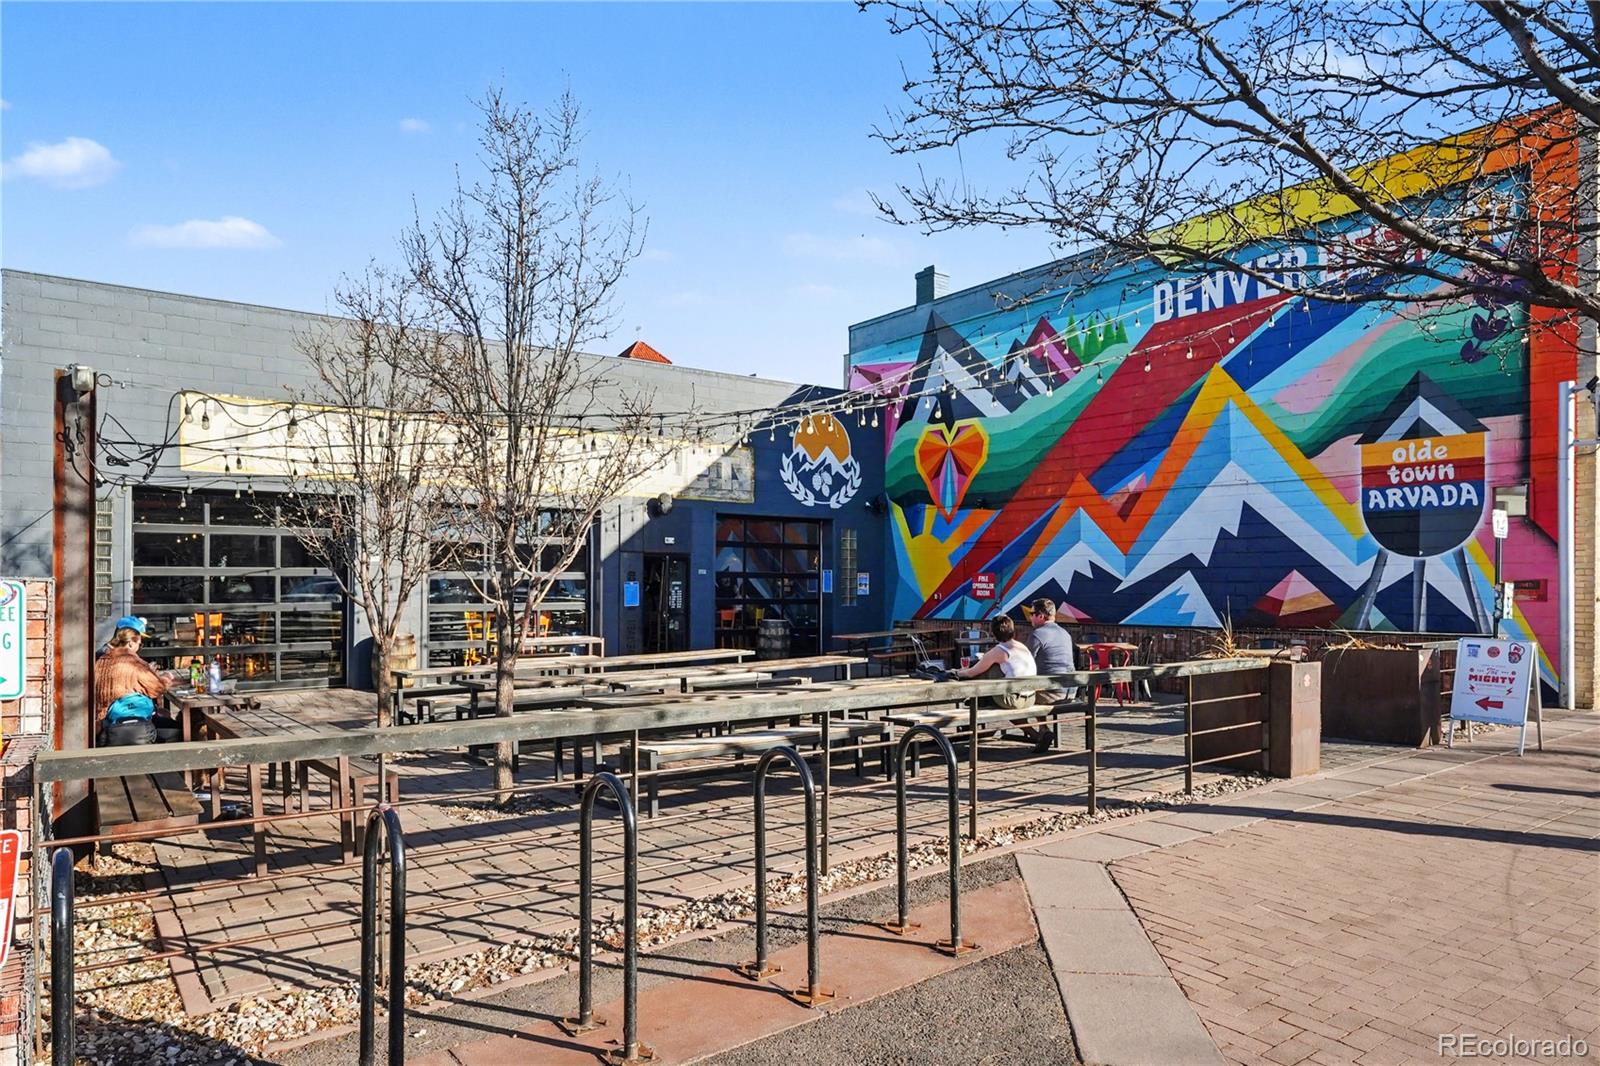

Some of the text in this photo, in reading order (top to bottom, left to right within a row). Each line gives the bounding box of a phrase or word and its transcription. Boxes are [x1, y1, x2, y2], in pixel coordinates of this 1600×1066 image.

[1152, 246, 1308, 324] DENVER
[1391, 439, 1448, 463] olde
[1386, 462, 1455, 484] town
[1368, 482, 1479, 510] ARVADA
[1468, 674, 1516, 685] MIGHTY
